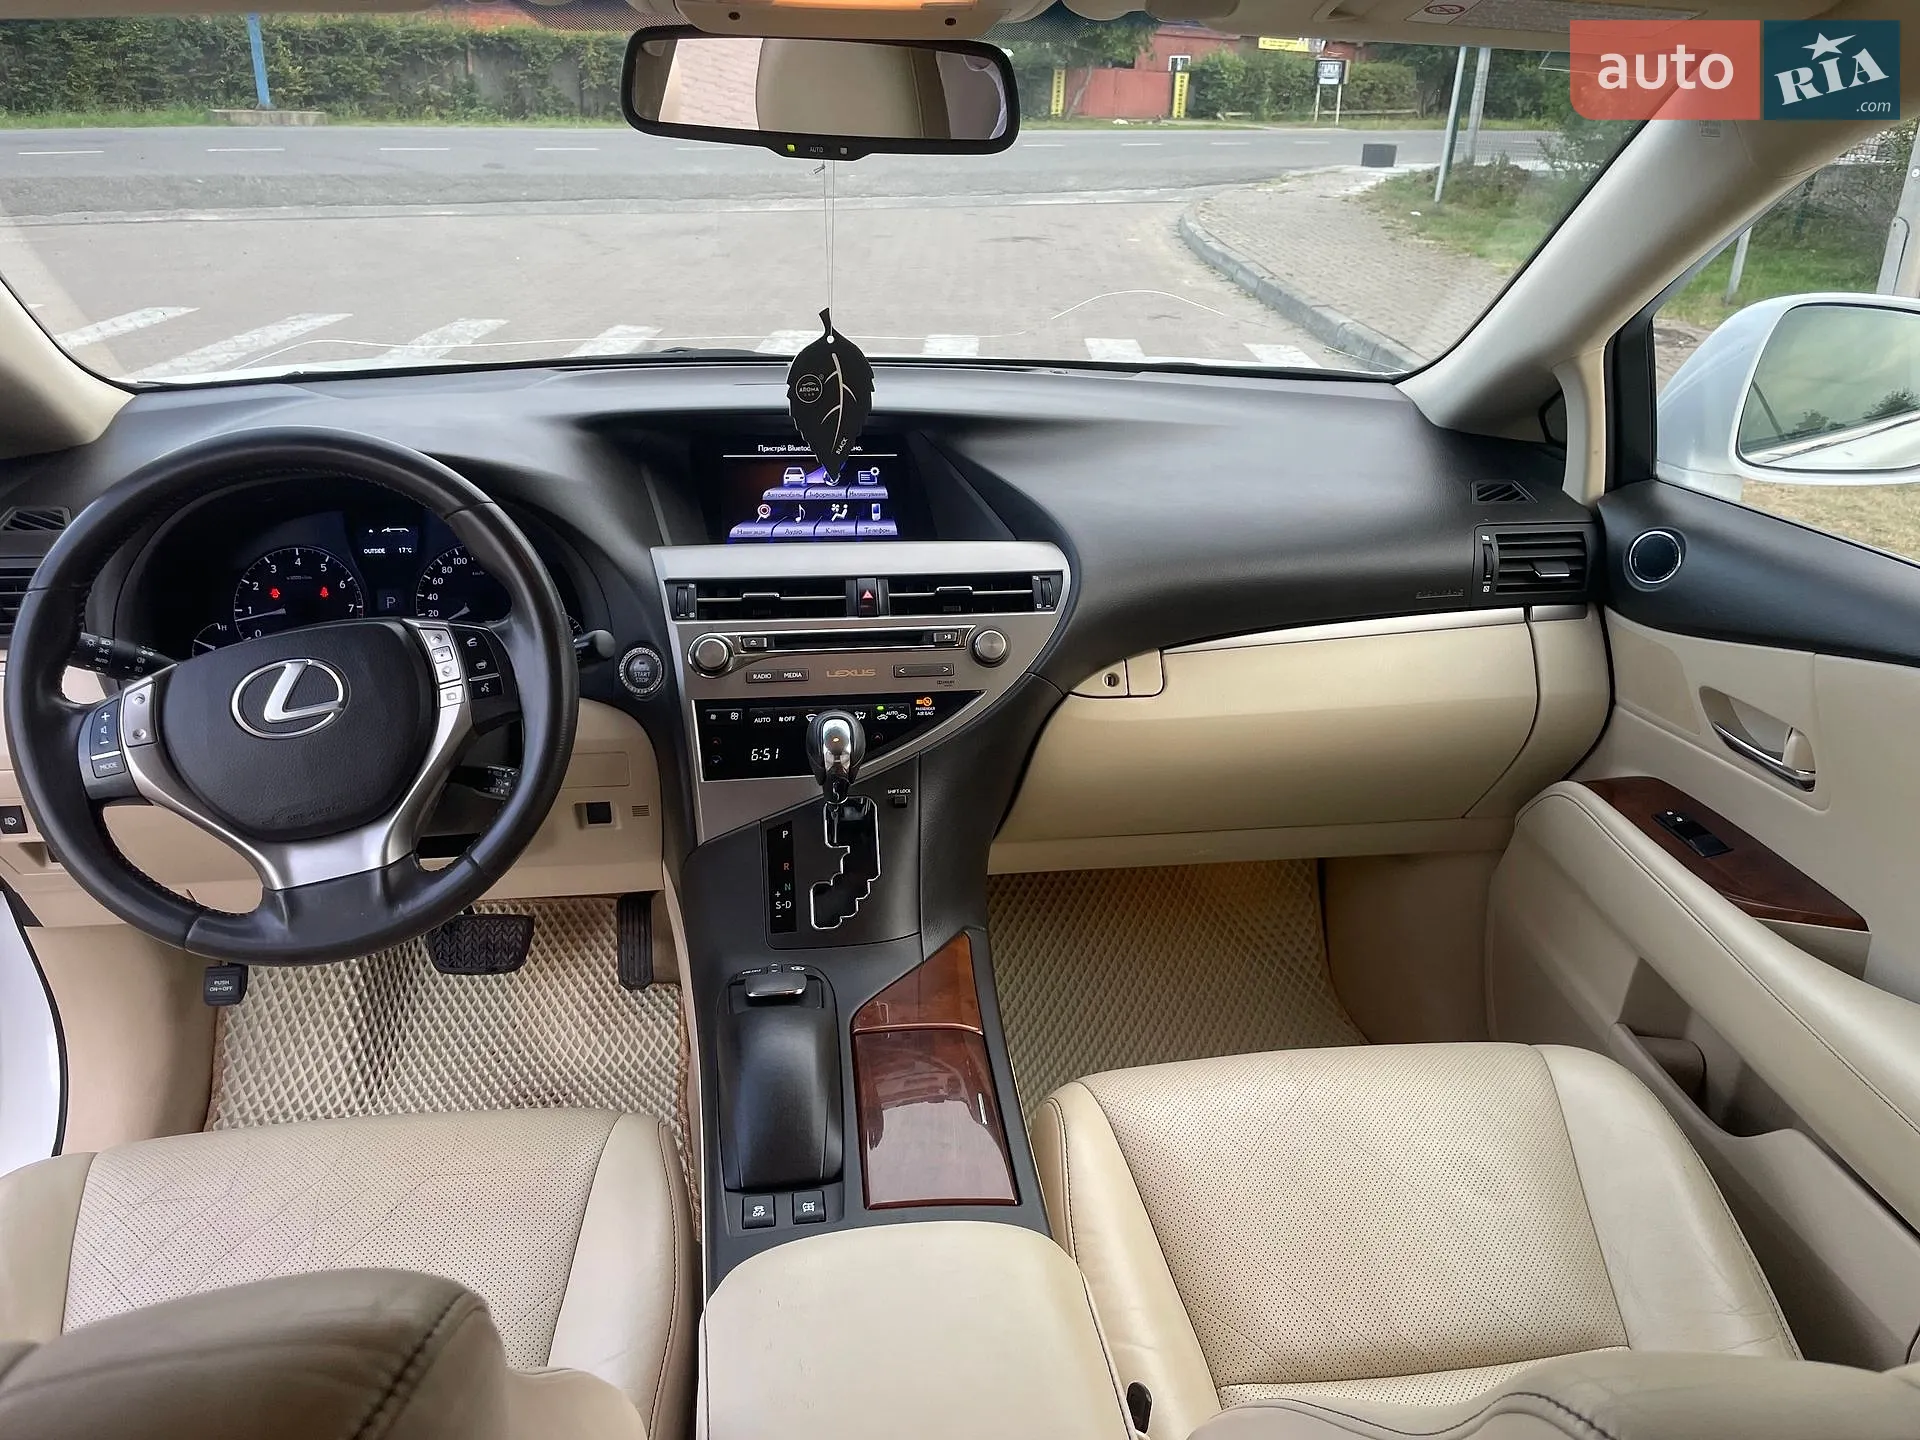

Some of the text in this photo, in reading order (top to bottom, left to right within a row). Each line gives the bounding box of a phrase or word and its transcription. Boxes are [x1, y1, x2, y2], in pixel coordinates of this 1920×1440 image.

[757, 444, 787, 453] Пристрій
[295, 558, 302, 566] 4
[453, 557, 468, 565] 100
[271, 564, 277, 573] 3
[320, 563, 327, 572] 5
[441, 566, 453, 574] 80
[339, 580, 346, 589] 6
[432, 577, 444, 585] 60
[253, 582, 260, 591] 2
[386, 597, 396, 609] P
[248, 606, 252, 614] 1
[348, 604, 355, 613] 7
[427, 609, 439, 617] 20
[254, 629, 262, 638] 0
[752, 670, 803, 681] RADIO MEDIA
[826, 668, 877, 678] LEXUS
[751, 747, 780, 761] 6:51
[99, 761, 119, 770] MODE
[782, 830, 789, 839] P
[783, 862, 790, 871] R
[784, 883, 791, 891] N
